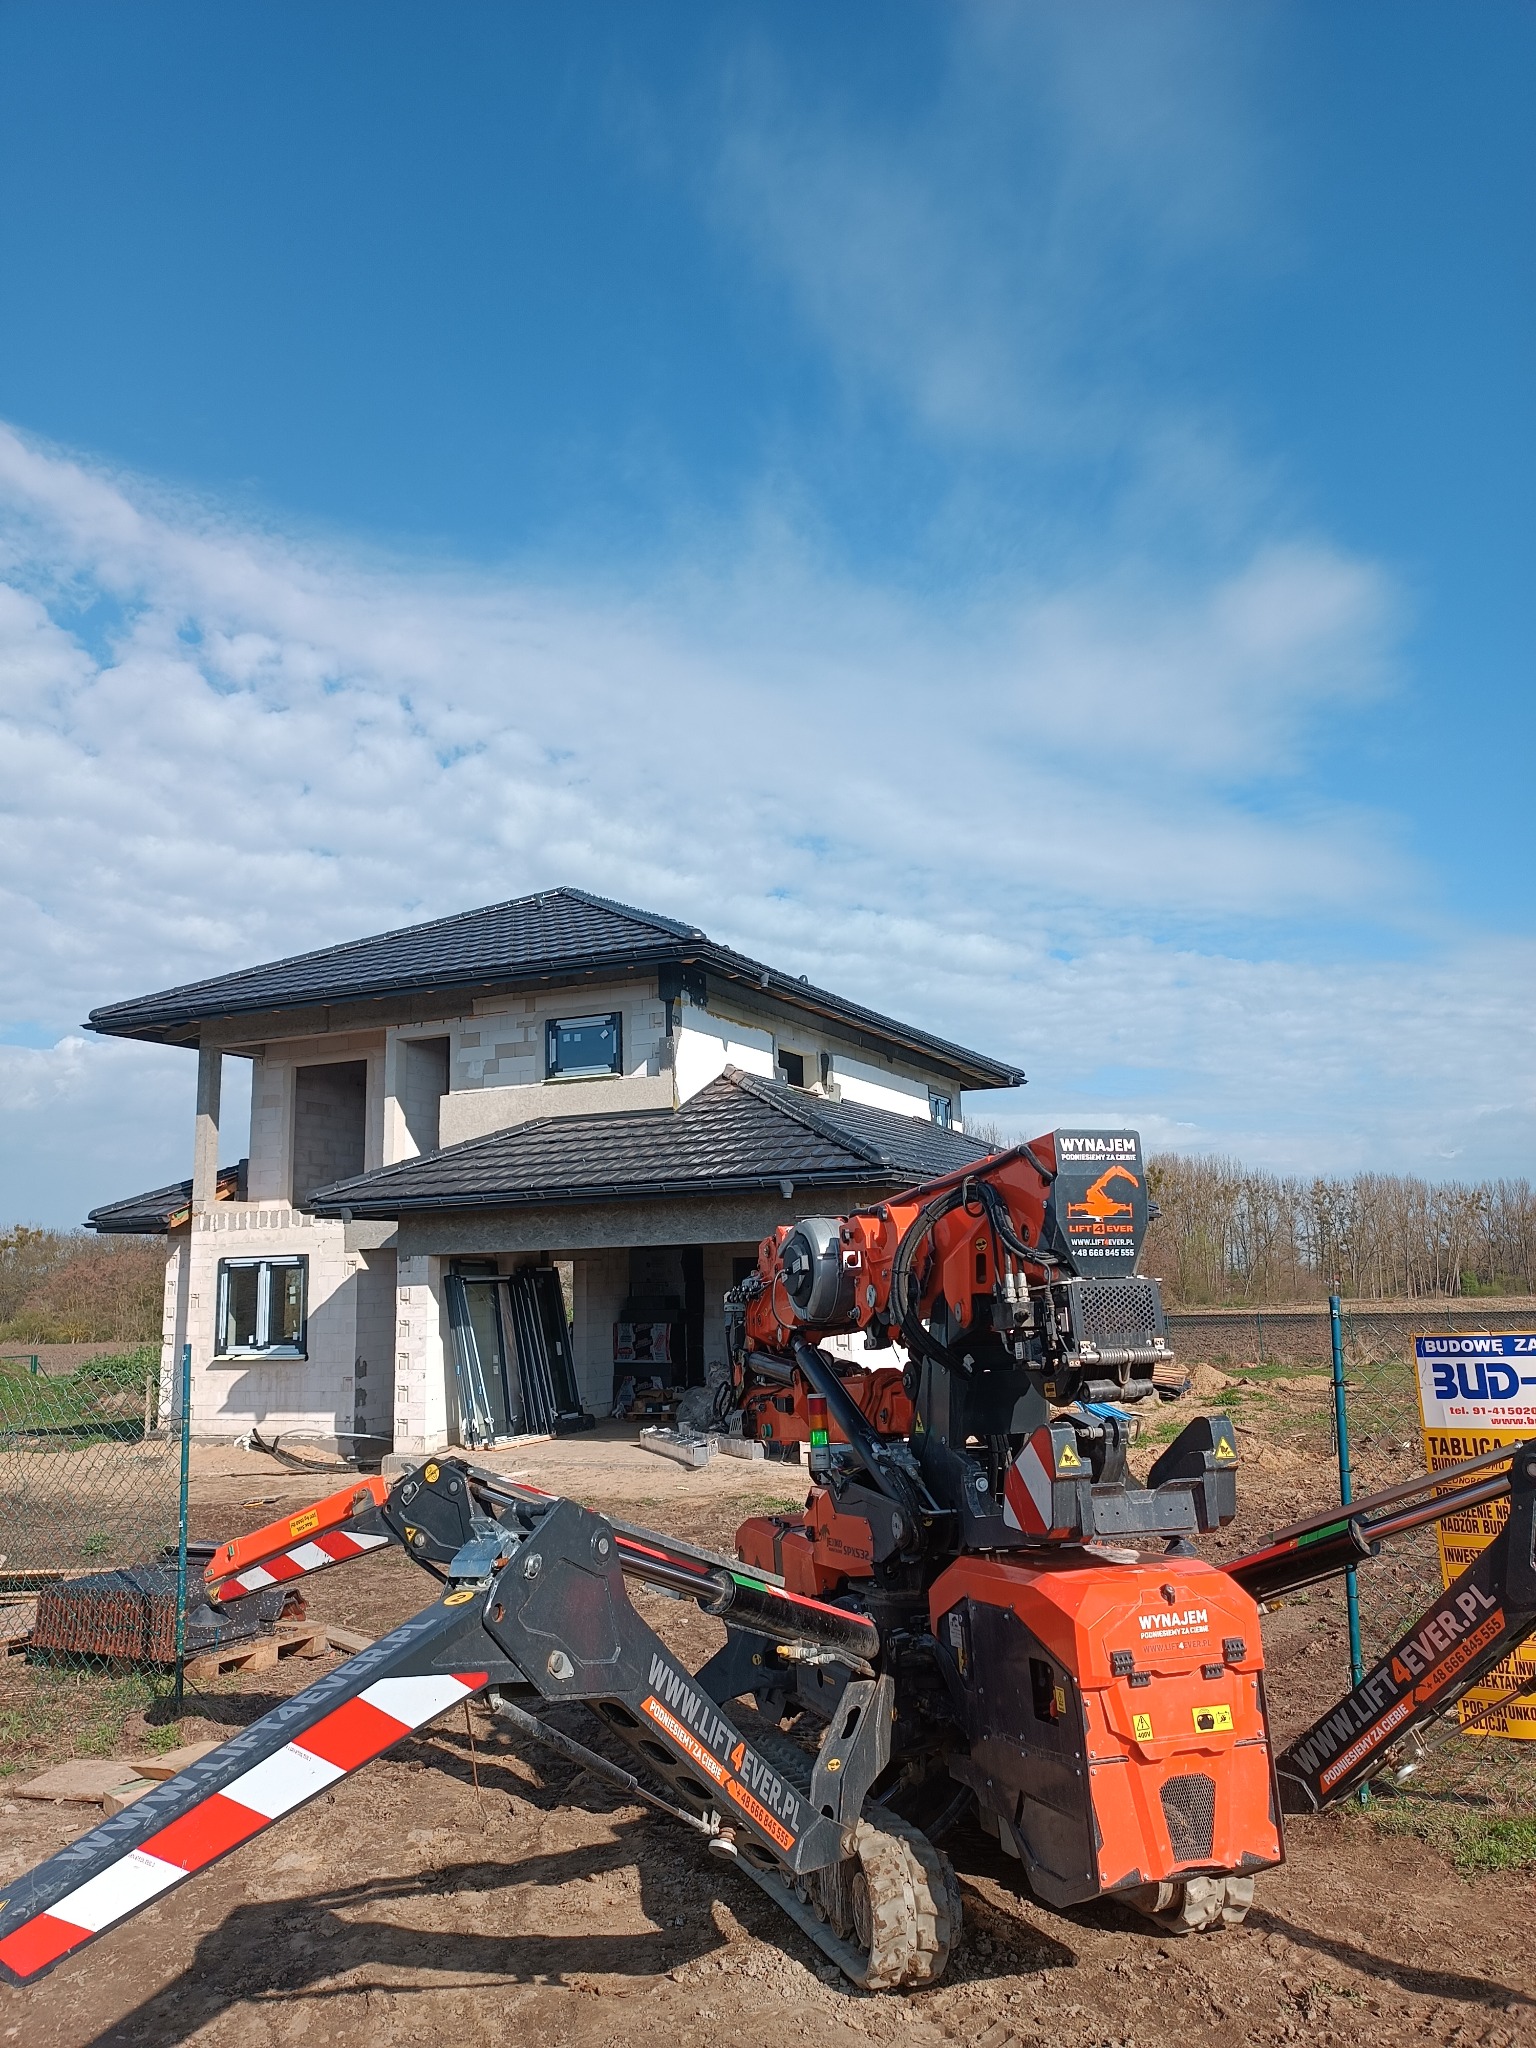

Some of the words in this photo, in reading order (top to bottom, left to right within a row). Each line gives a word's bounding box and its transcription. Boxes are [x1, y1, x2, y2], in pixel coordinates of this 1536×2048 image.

[1060, 1138, 1136, 1152] WYNAJEM
[1061, 1153, 1105, 1161] PODNIESIEMY
[1106, 1153, 1115, 1161] ZA
[1069, 1225, 1092, 1233] LIFT
[1106, 1225, 1134, 1233] EVER
[1071, 1238, 1135, 1246] WWW.LIFT4EVER.PL
[1105, 1249, 1120, 1257] 845
[1120, 1249, 1135, 1257] 555
[1424, 1339, 1504, 1355] BUDOWĘ
[1449, 1406, 1469, 1415] tel.
[1491, 1416, 1536, 1425] www.b
[1441, 1518, 1480, 1534] NADZÓR
[1138, 1609, 1208, 1630] WYNAJEM
[1181, 1627, 1190, 1635] ZA
[1143, 1640, 1212, 1653] WWW.LIFT4EVER.PL
[1292, 1583, 1497, 1775] WWW.LIFT4EVER.PL
[1323, 1737, 1375, 1785] PODNIESIEMY
[1370, 1728, 1386, 1744] ZA
[1382, 1703, 1409, 1731] CIEBIE
[1447, 1652, 1465, 1674] 666
[1462, 1635, 1483, 1657] 845
[1481, 1618, 1502, 1640] 555
[54, 1619, 438, 1861] WWW.LIFT4EVER.PL
[648, 1652, 800, 1833] WWW.LIFT4EVER.PL
[649, 1700, 694, 1751] PODNIESIEMY
[692, 1743, 702, 1760] ZA
[701, 1752, 723, 1781] CIEBIE
[750, 1800, 764, 1821] 666
[763, 1814, 777, 1835] 845
[776, 1827, 789, 1847] 555
